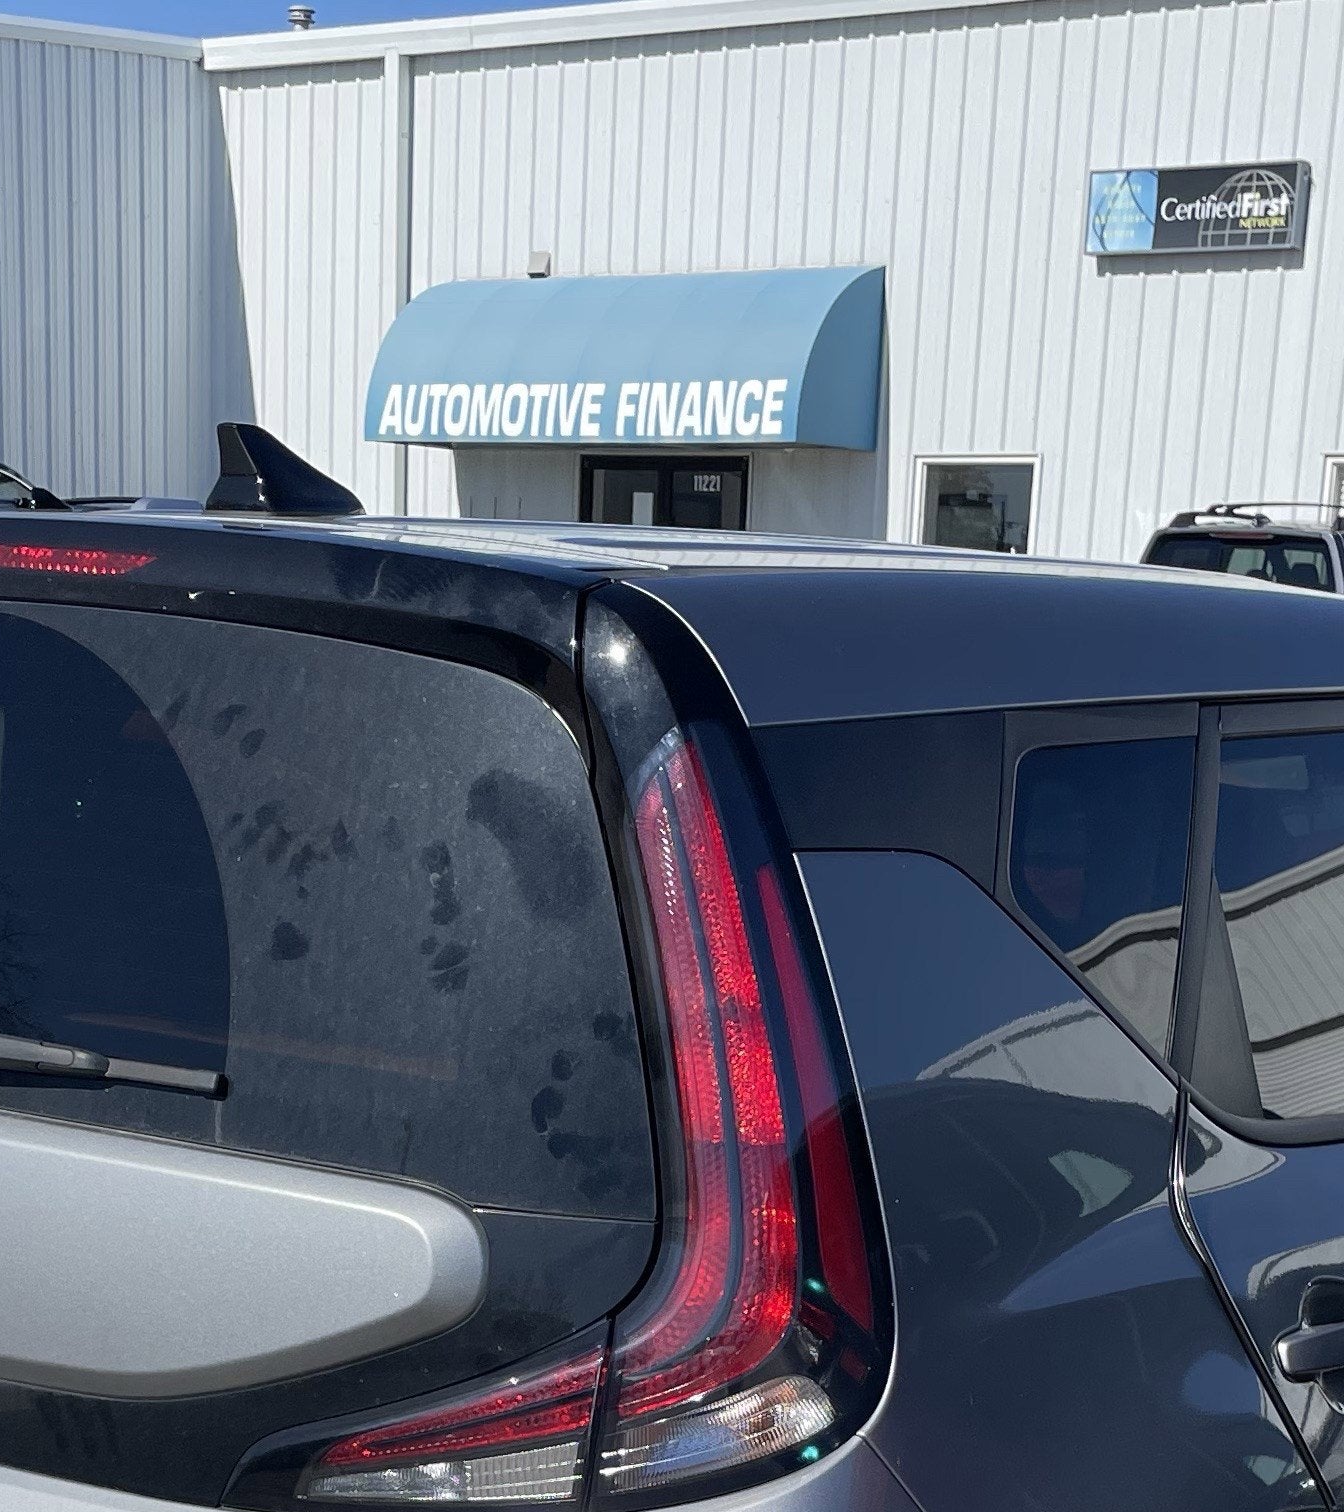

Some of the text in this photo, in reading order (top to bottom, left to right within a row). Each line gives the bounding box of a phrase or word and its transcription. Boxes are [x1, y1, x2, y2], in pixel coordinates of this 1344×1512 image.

[379, 379, 789, 437] AUTOMOTIVE FINANCE
[693, 475, 721, 491] 11221
